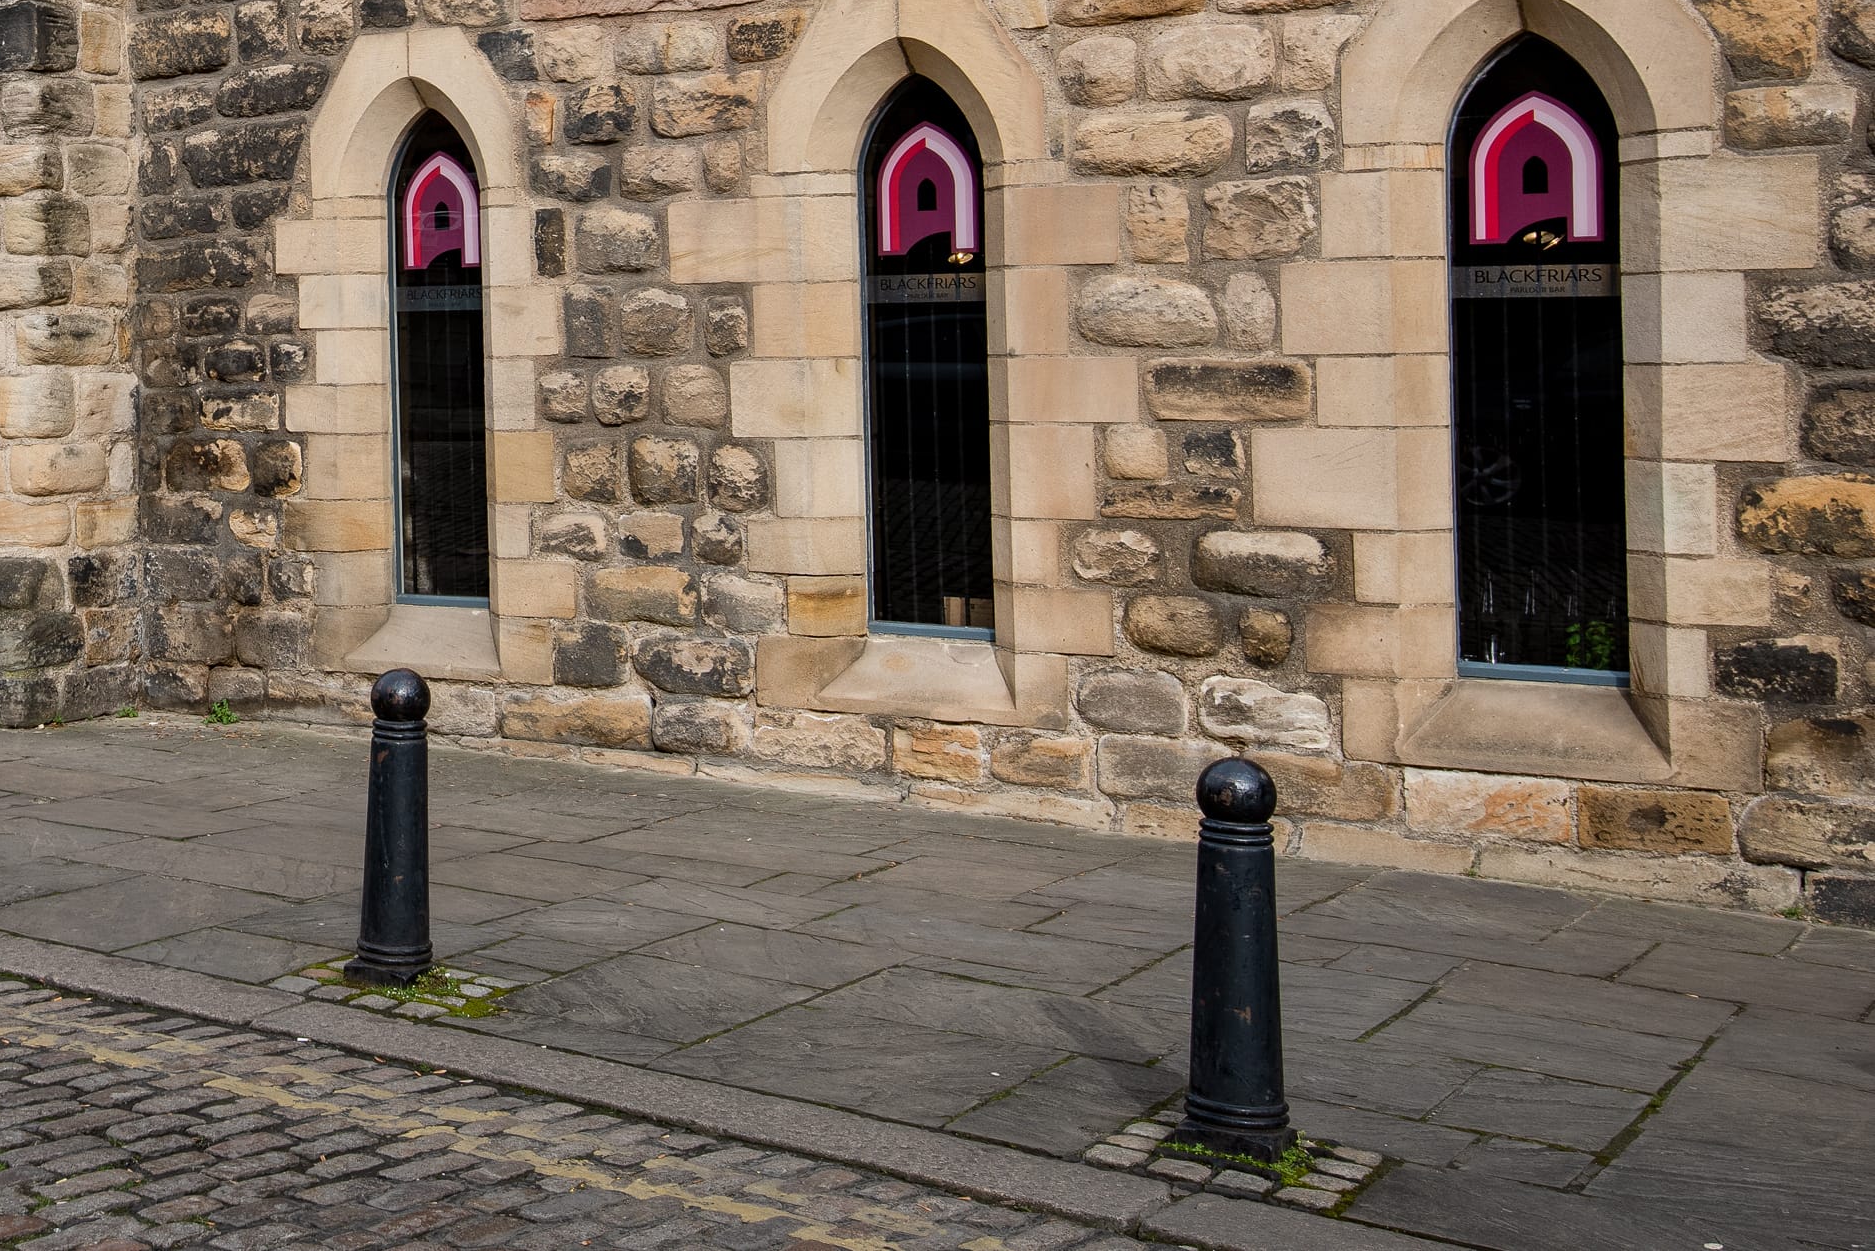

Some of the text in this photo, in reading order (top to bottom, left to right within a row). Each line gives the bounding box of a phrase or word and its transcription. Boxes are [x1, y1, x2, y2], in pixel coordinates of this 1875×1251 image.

[1475, 268, 1602, 284] BLACKFRIARS
[880, 276, 976, 291] BLACKFRIARS
[1510, 286, 1547, 294] PARLOUR
[407, 288, 482, 300] BLACKFRIARS
